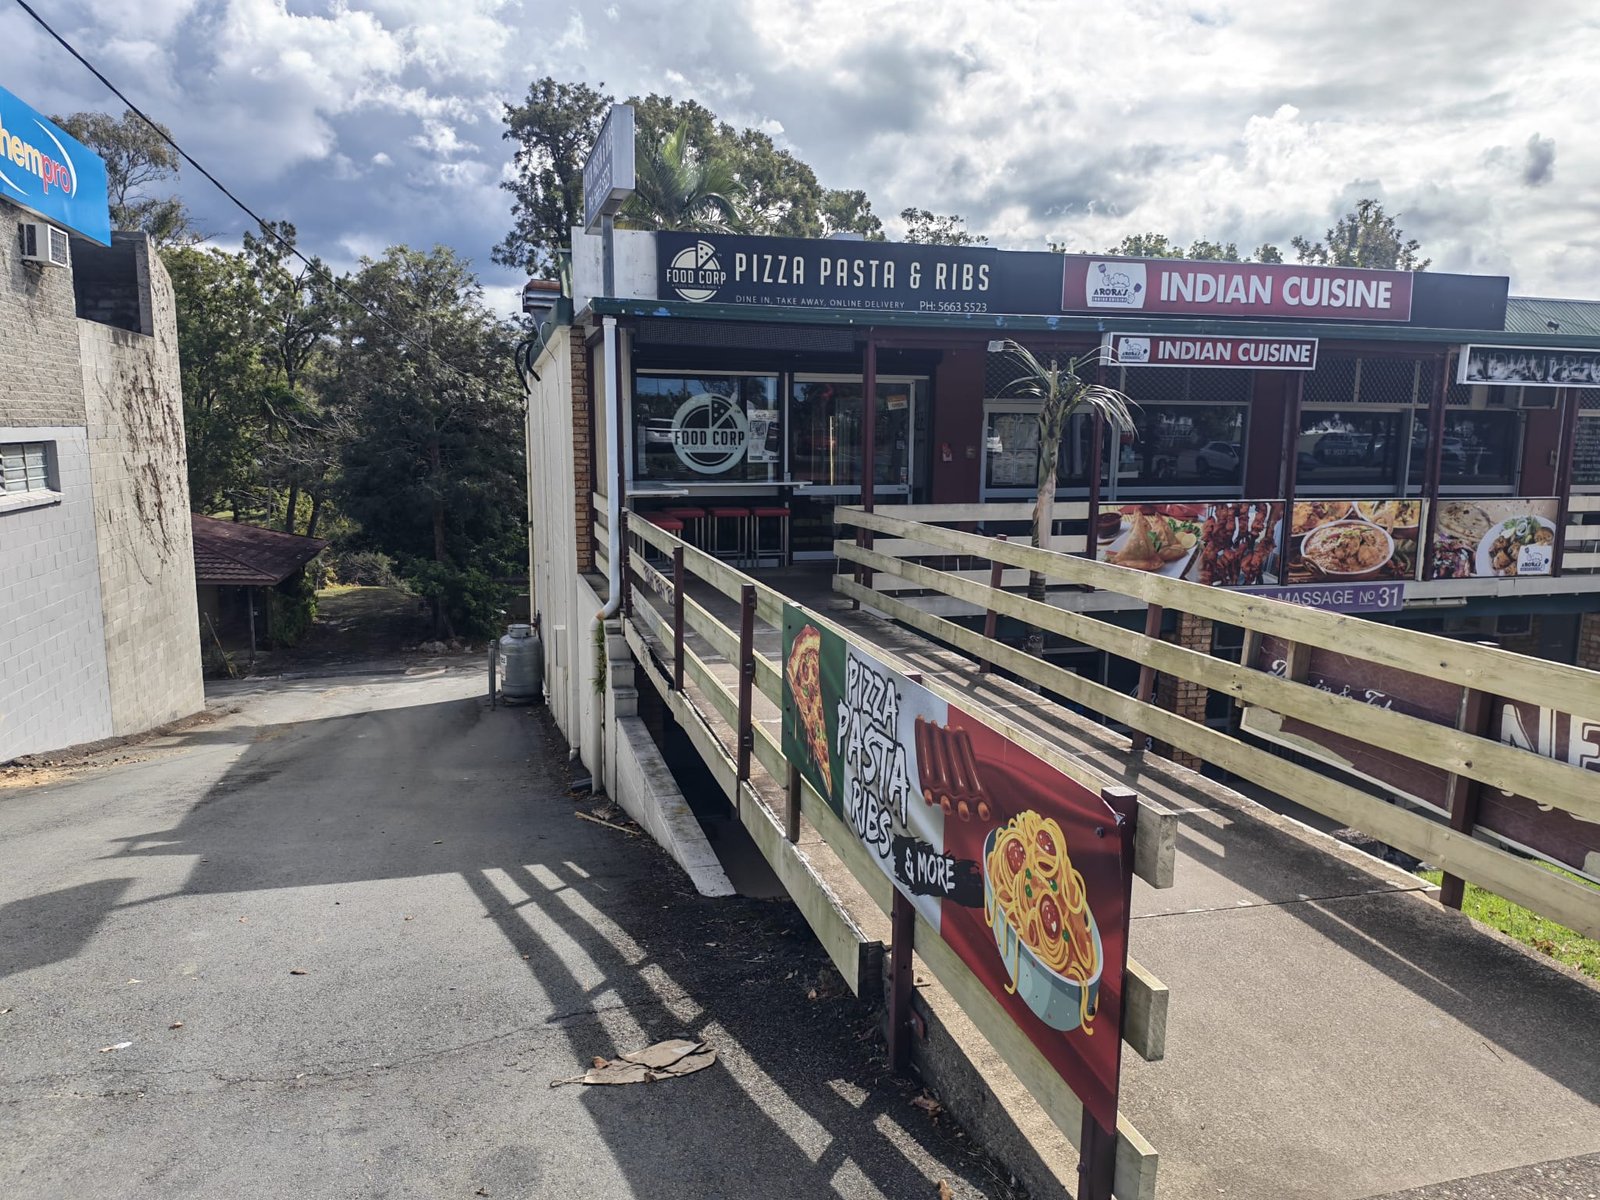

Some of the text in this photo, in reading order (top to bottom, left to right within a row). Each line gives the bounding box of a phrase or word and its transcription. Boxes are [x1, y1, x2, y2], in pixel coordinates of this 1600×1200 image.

[666, 269, 727, 285] FOOD CORP
[735, 252, 990, 291] PIZZA PASTA & RIBS
[735, 295, 757, 303] DINE
[776, 297, 797, 305] TAKE
[801, 298, 827, 307] AWAY,
[829, 299, 862, 307] ONLINE
[864, 300, 905, 309] DELIVERY
[1160, 271, 1393, 309] INDIAN CUISINE
[920, 300, 988, 313] PH: 5663 5523
[1158, 340, 1311, 363] INDIAN CUISINE
[674, 430, 745, 446] FOOD CORP
[1278, 590, 1354, 608] MASSAGE
[1377, 586, 1399, 608] 31
[847, 652, 899, 742] PIZZA
[837, 698, 910, 828] PASTA
[852, 778, 892, 859] RIBS
[904, 847, 956, 895] & MORE
